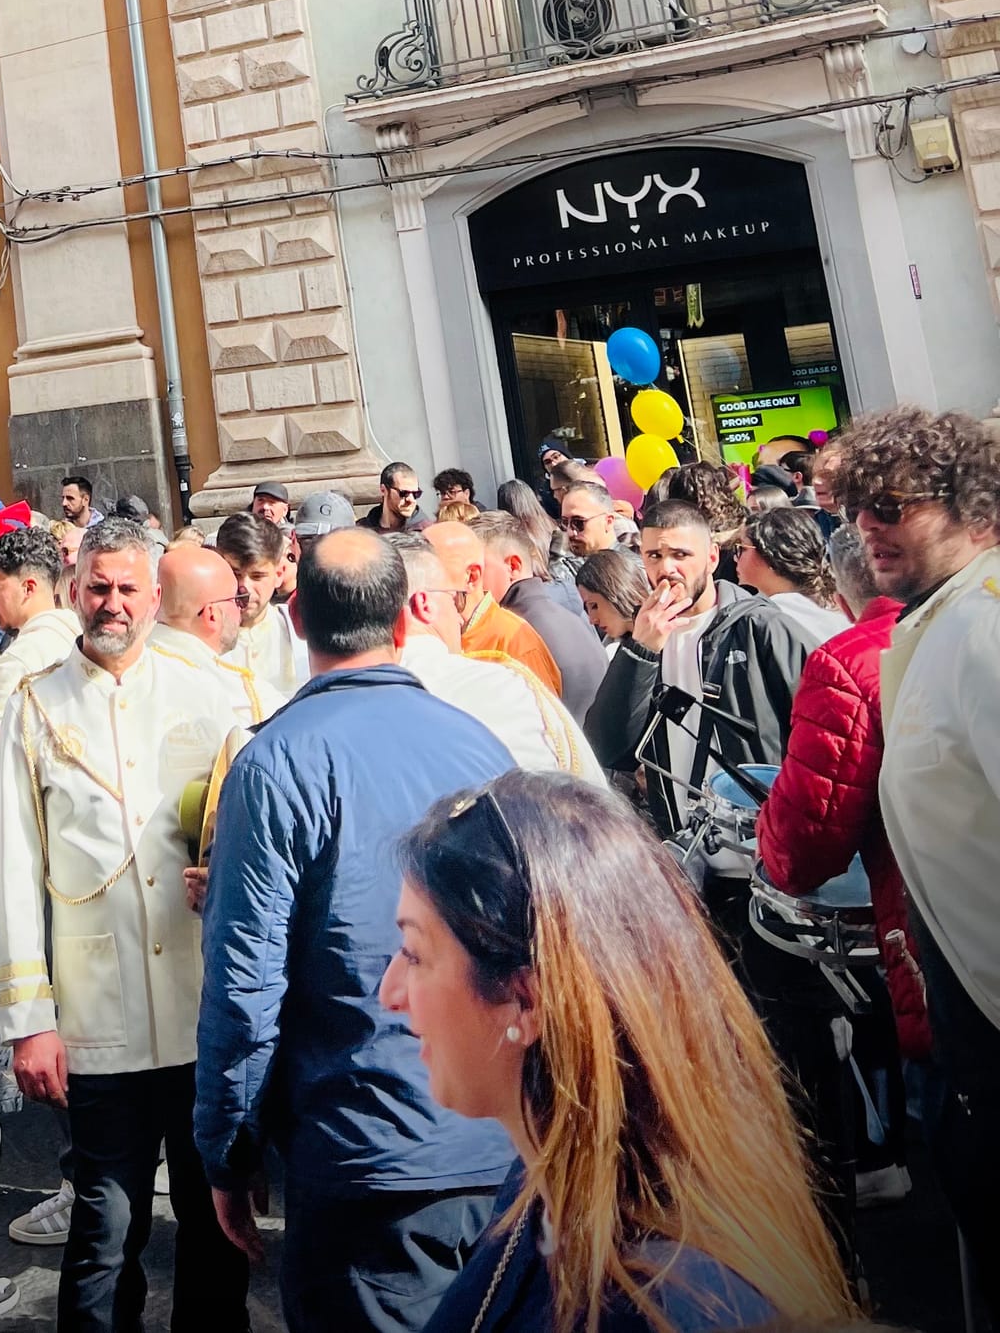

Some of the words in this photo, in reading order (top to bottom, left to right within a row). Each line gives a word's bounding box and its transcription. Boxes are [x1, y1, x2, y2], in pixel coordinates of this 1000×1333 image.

[556, 167, 707, 229] NYX
[512, 235, 670, 268] PROFESSIONAL
[684, 221, 771, 244] MAKEUP
[719, 401, 746, 412] GOOD
[747, 399, 772, 409] BASE
[773, 396, 796, 406] ONLY
[721, 416, 759, 427] PROMO
[725, 432, 751, 443] -50%
